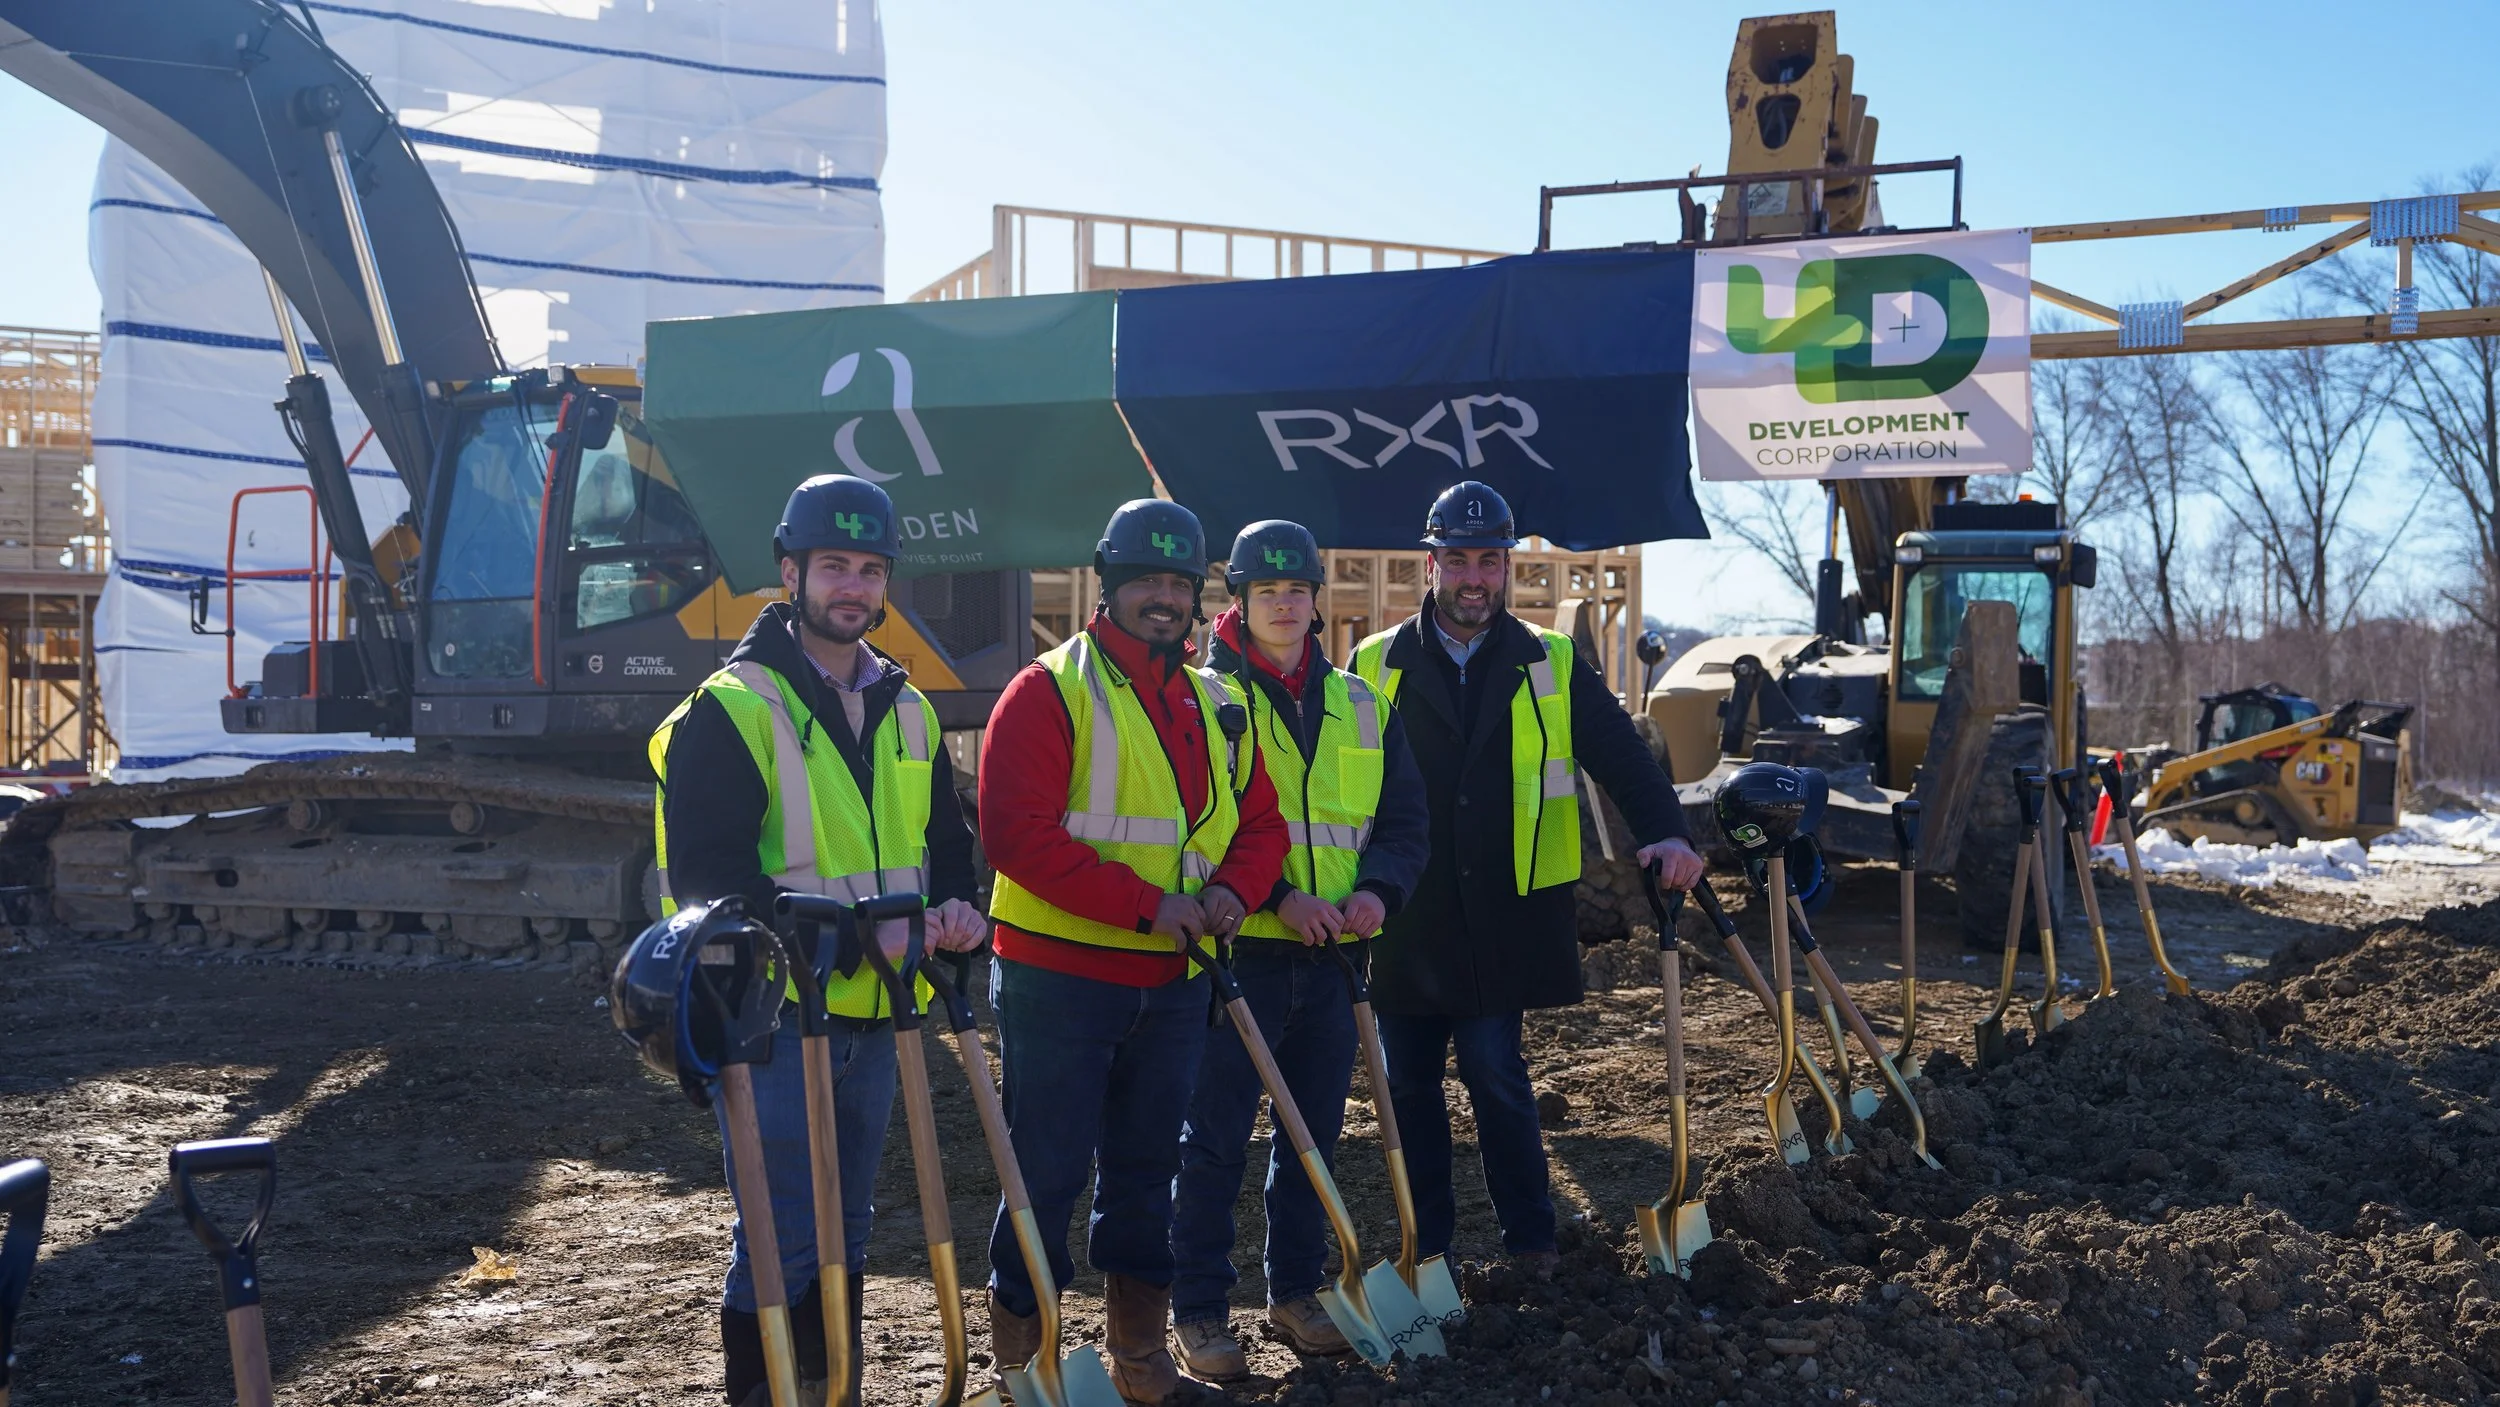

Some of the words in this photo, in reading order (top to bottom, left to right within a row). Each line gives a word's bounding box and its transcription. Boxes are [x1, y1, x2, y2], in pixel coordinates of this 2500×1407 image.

[1726, 253, 1990, 404] 4D
[1257, 393, 1555, 471] RXR
[1749, 411, 1970, 441] DEVELOPMENT
[1756, 440, 1958, 466] CORPORATION
[898, 507, 980, 540] DEN
[902, 553, 937, 564] VIES
[939, 552, 984, 564] POINT
[623, 666, 677, 676] CONTROL
[625, 656, 665, 666] ACTIVE
[2296, 761, 2324, 780] CAT
[1779, 1132, 1805, 1151] RXR
[1390, 1314, 1434, 1349] RXR
